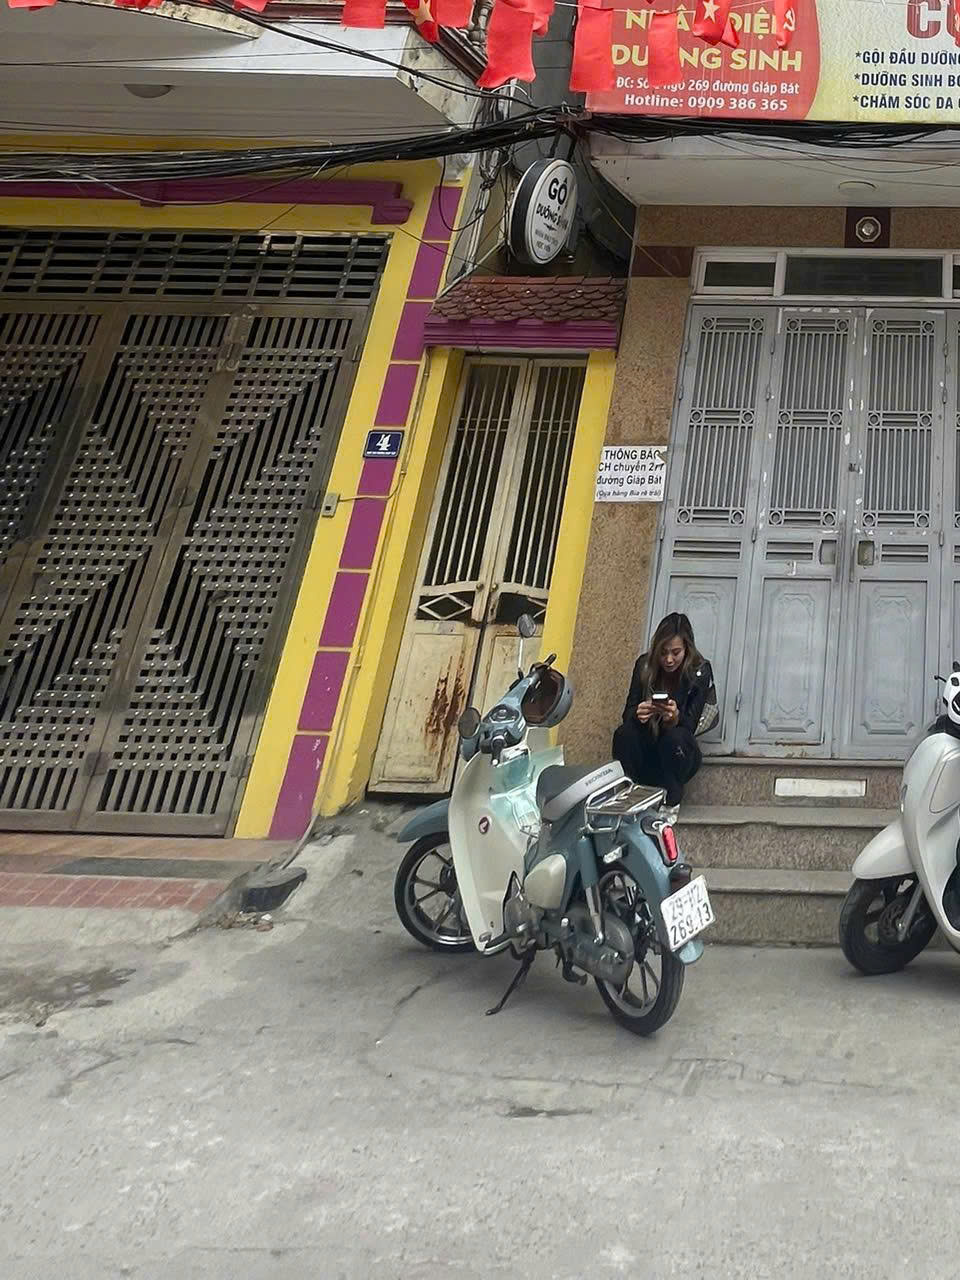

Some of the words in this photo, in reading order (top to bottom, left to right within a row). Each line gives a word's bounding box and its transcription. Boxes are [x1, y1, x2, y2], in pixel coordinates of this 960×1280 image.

[729, 49, 802, 72] SINH
[616, 76, 634, 88] ĐC:
[688, 79, 710, 91] 269
[712, 80, 749, 95] đường
[752, 81, 777, 96] Giáp
[780, 81, 800, 94] Bát
[912, 74, 943, 87] SINH
[625, 93, 684, 108] Hotline:
[688, 96, 725, 109] 0909
[728, 97, 757, 110] 386
[760, 98, 788, 111] 365
[905, 93, 930, 109] SÓC
[936, 97, 953, 109] DA
[376, 434, 391, 450] 4
[605, 448, 637, 460] THÔNG
[598, 462, 611, 471] CH
